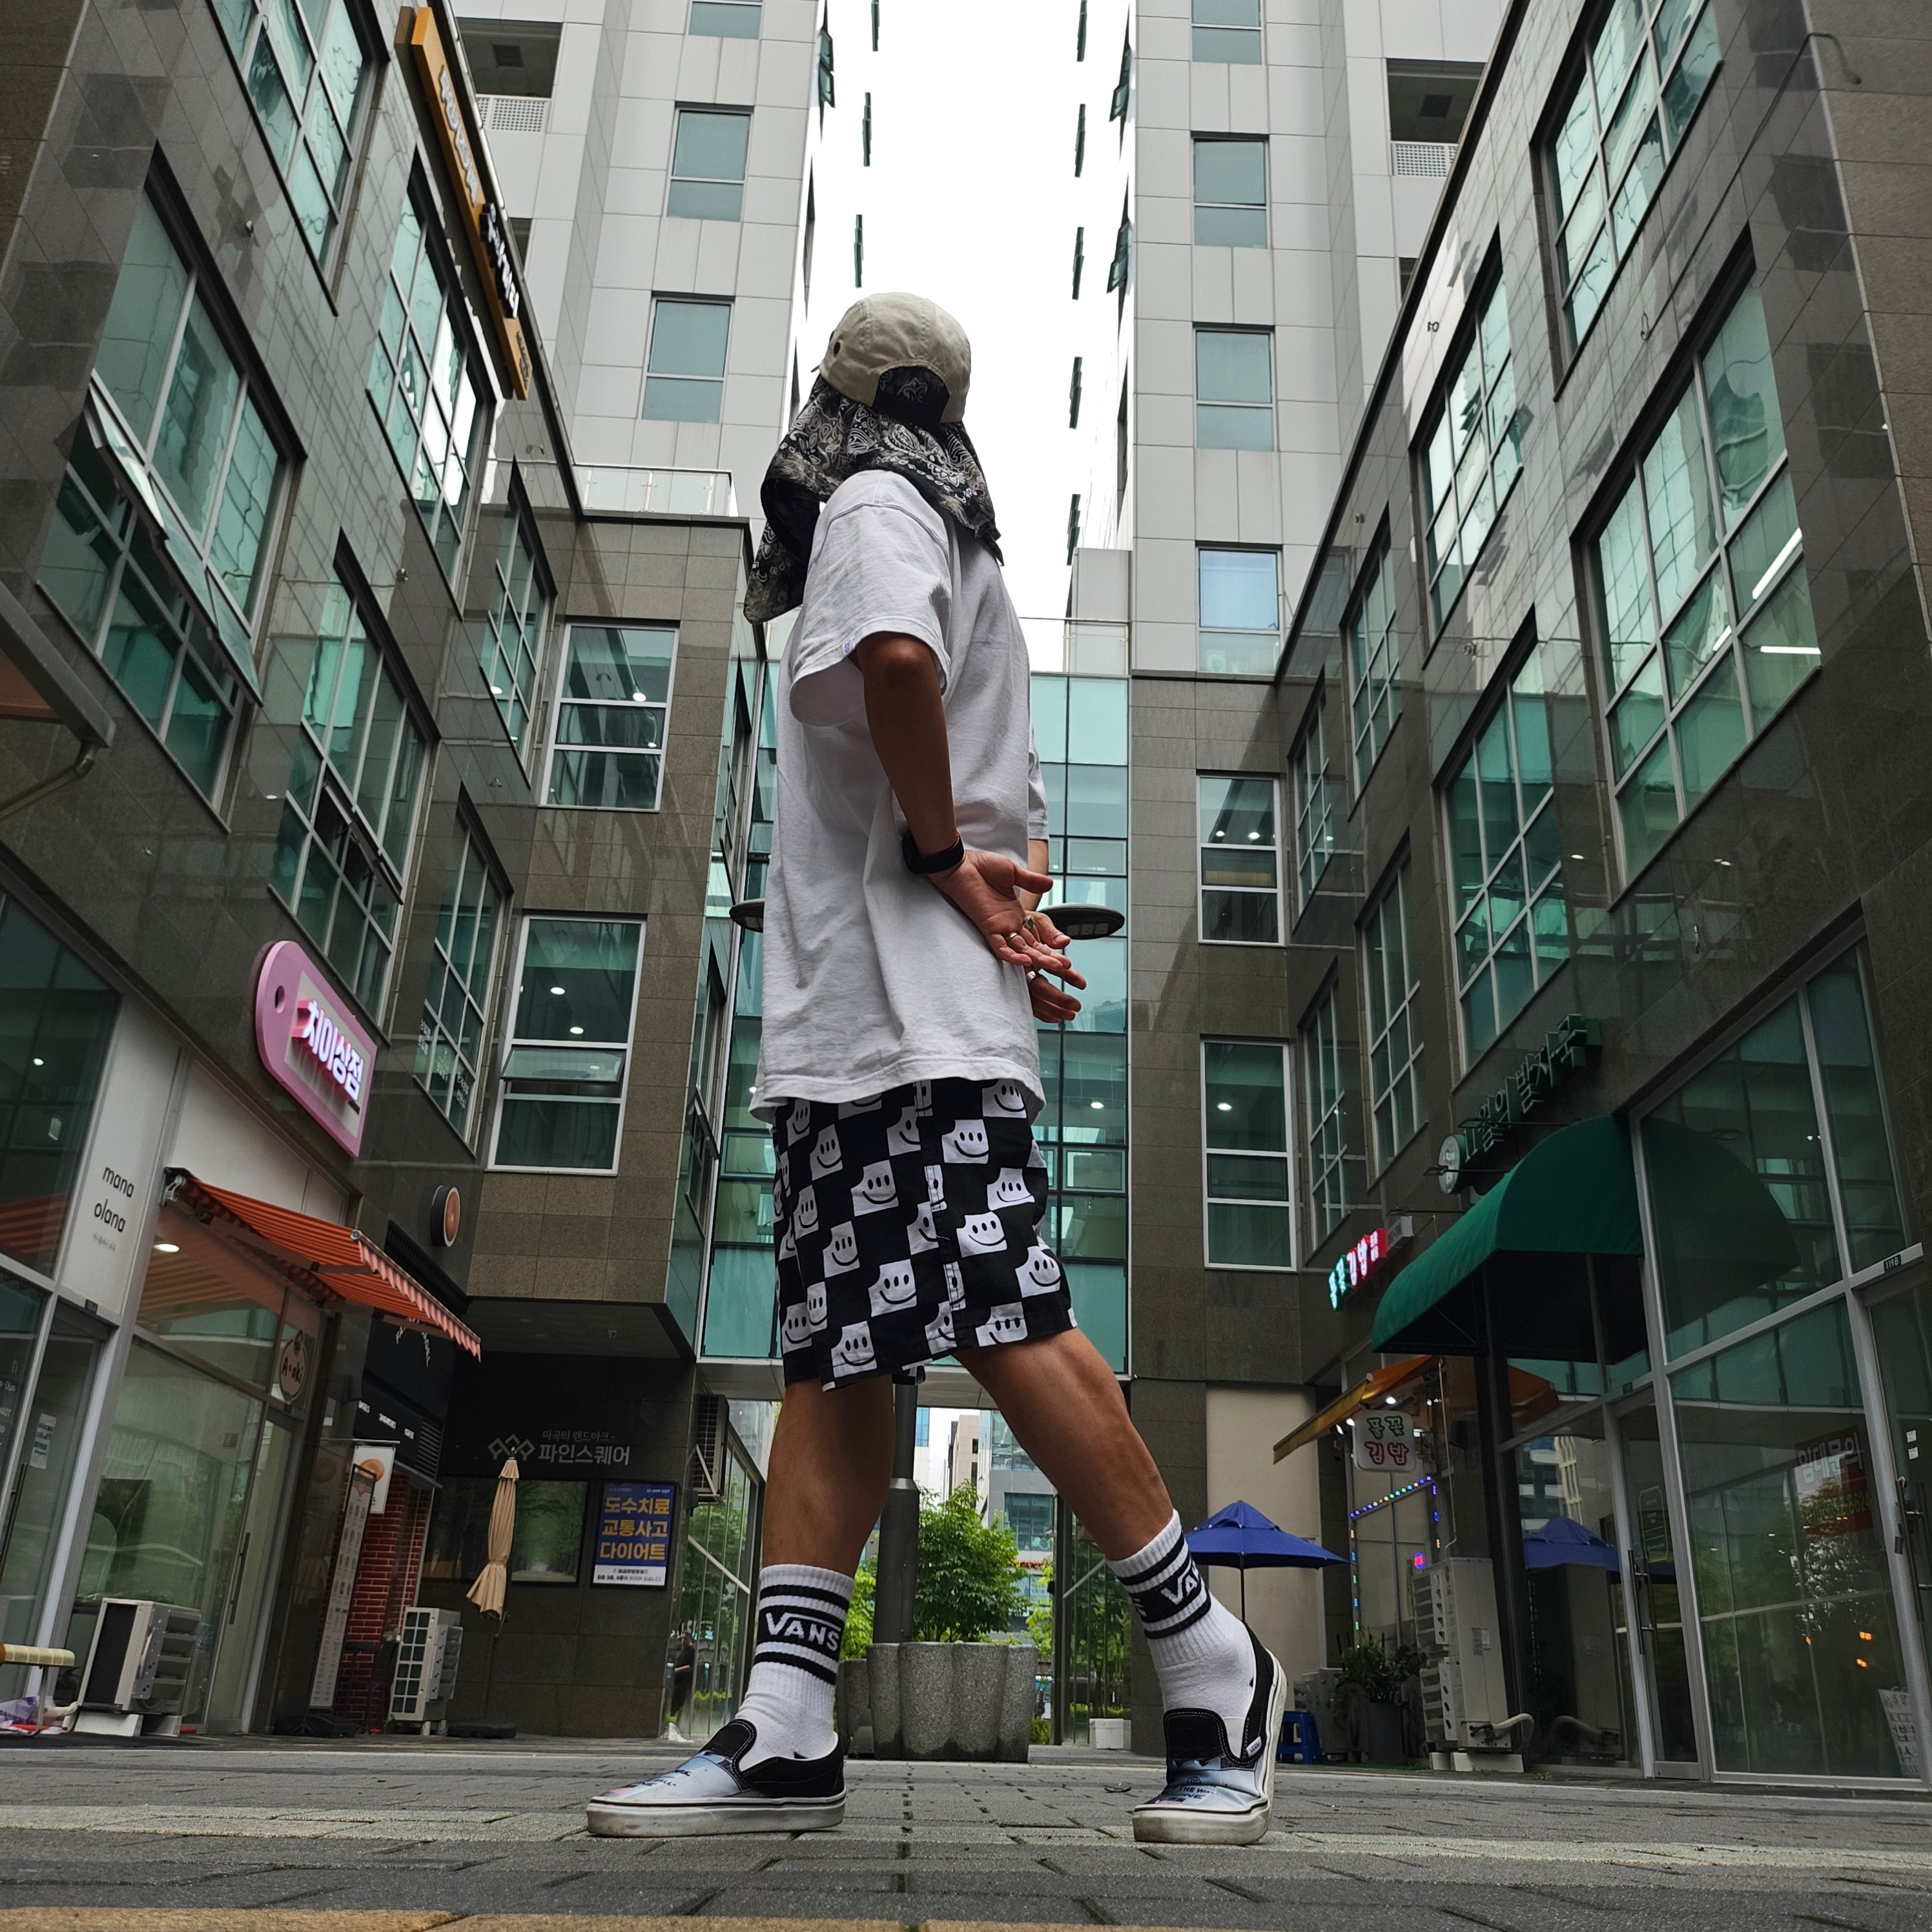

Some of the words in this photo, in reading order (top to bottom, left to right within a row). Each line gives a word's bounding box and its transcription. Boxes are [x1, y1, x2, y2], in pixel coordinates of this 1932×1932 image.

[103, 1167, 134, 1198] mana
[94, 1198, 126, 1233] olana
[1886, 1257, 1899, 1269] 119B
[542, 1429, 571, 1441] 마곡의
[538, 1443, 631, 1465] 파인스퀘어
[1364, 1441, 1410, 1466] 김밥
[1798, 1432, 1864, 1484] 임대문의
[604, 1497, 670, 1515] 도수치료
[602, 1519, 668, 1537] 교통사고
[600, 1541, 666, 1560] 다이어트
[766, 1612, 841, 1652] VANS
